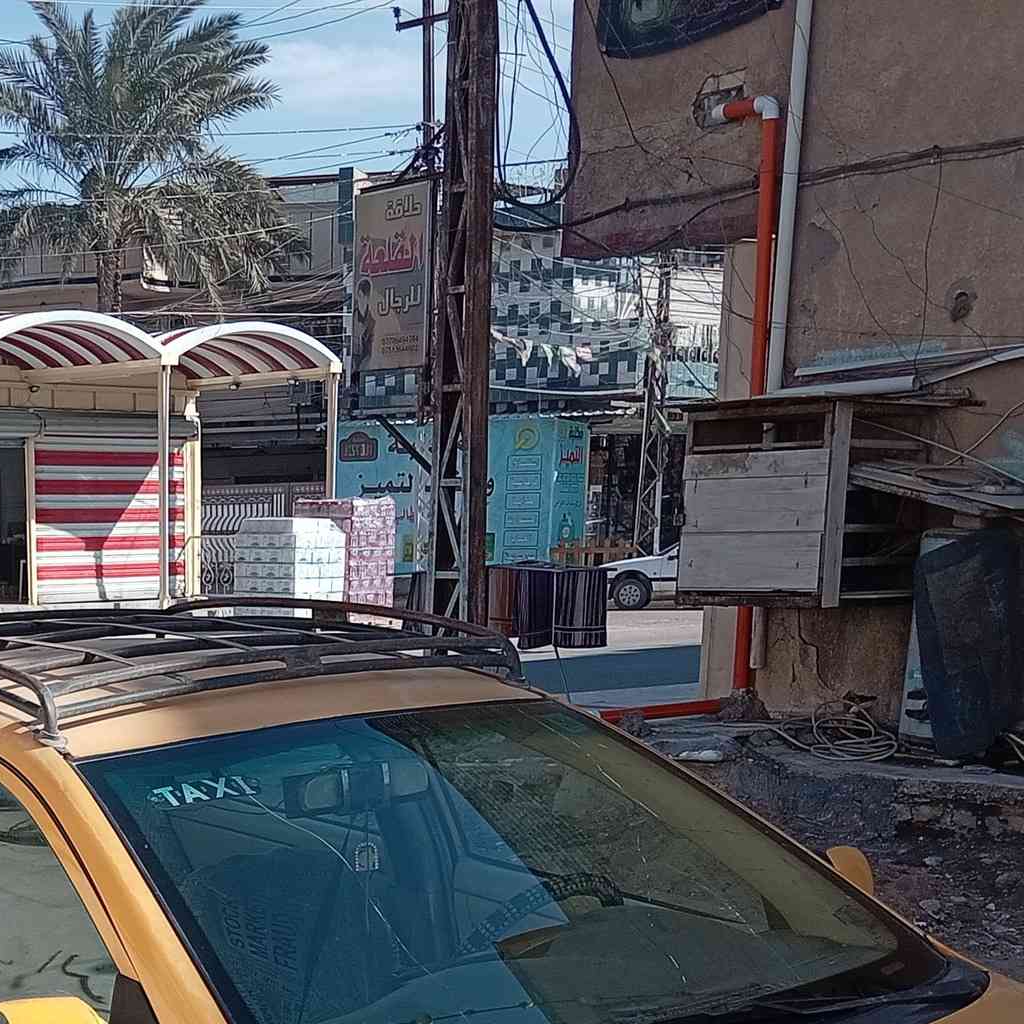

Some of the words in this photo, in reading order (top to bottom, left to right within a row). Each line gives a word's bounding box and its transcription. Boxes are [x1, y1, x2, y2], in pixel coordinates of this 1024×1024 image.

[384, 194, 423, 221] حلاقة
[378, 284, 423, 316] للرجال
[358, 472, 414, 498] لتميز
[152, 776, 256, 807] TAXI
